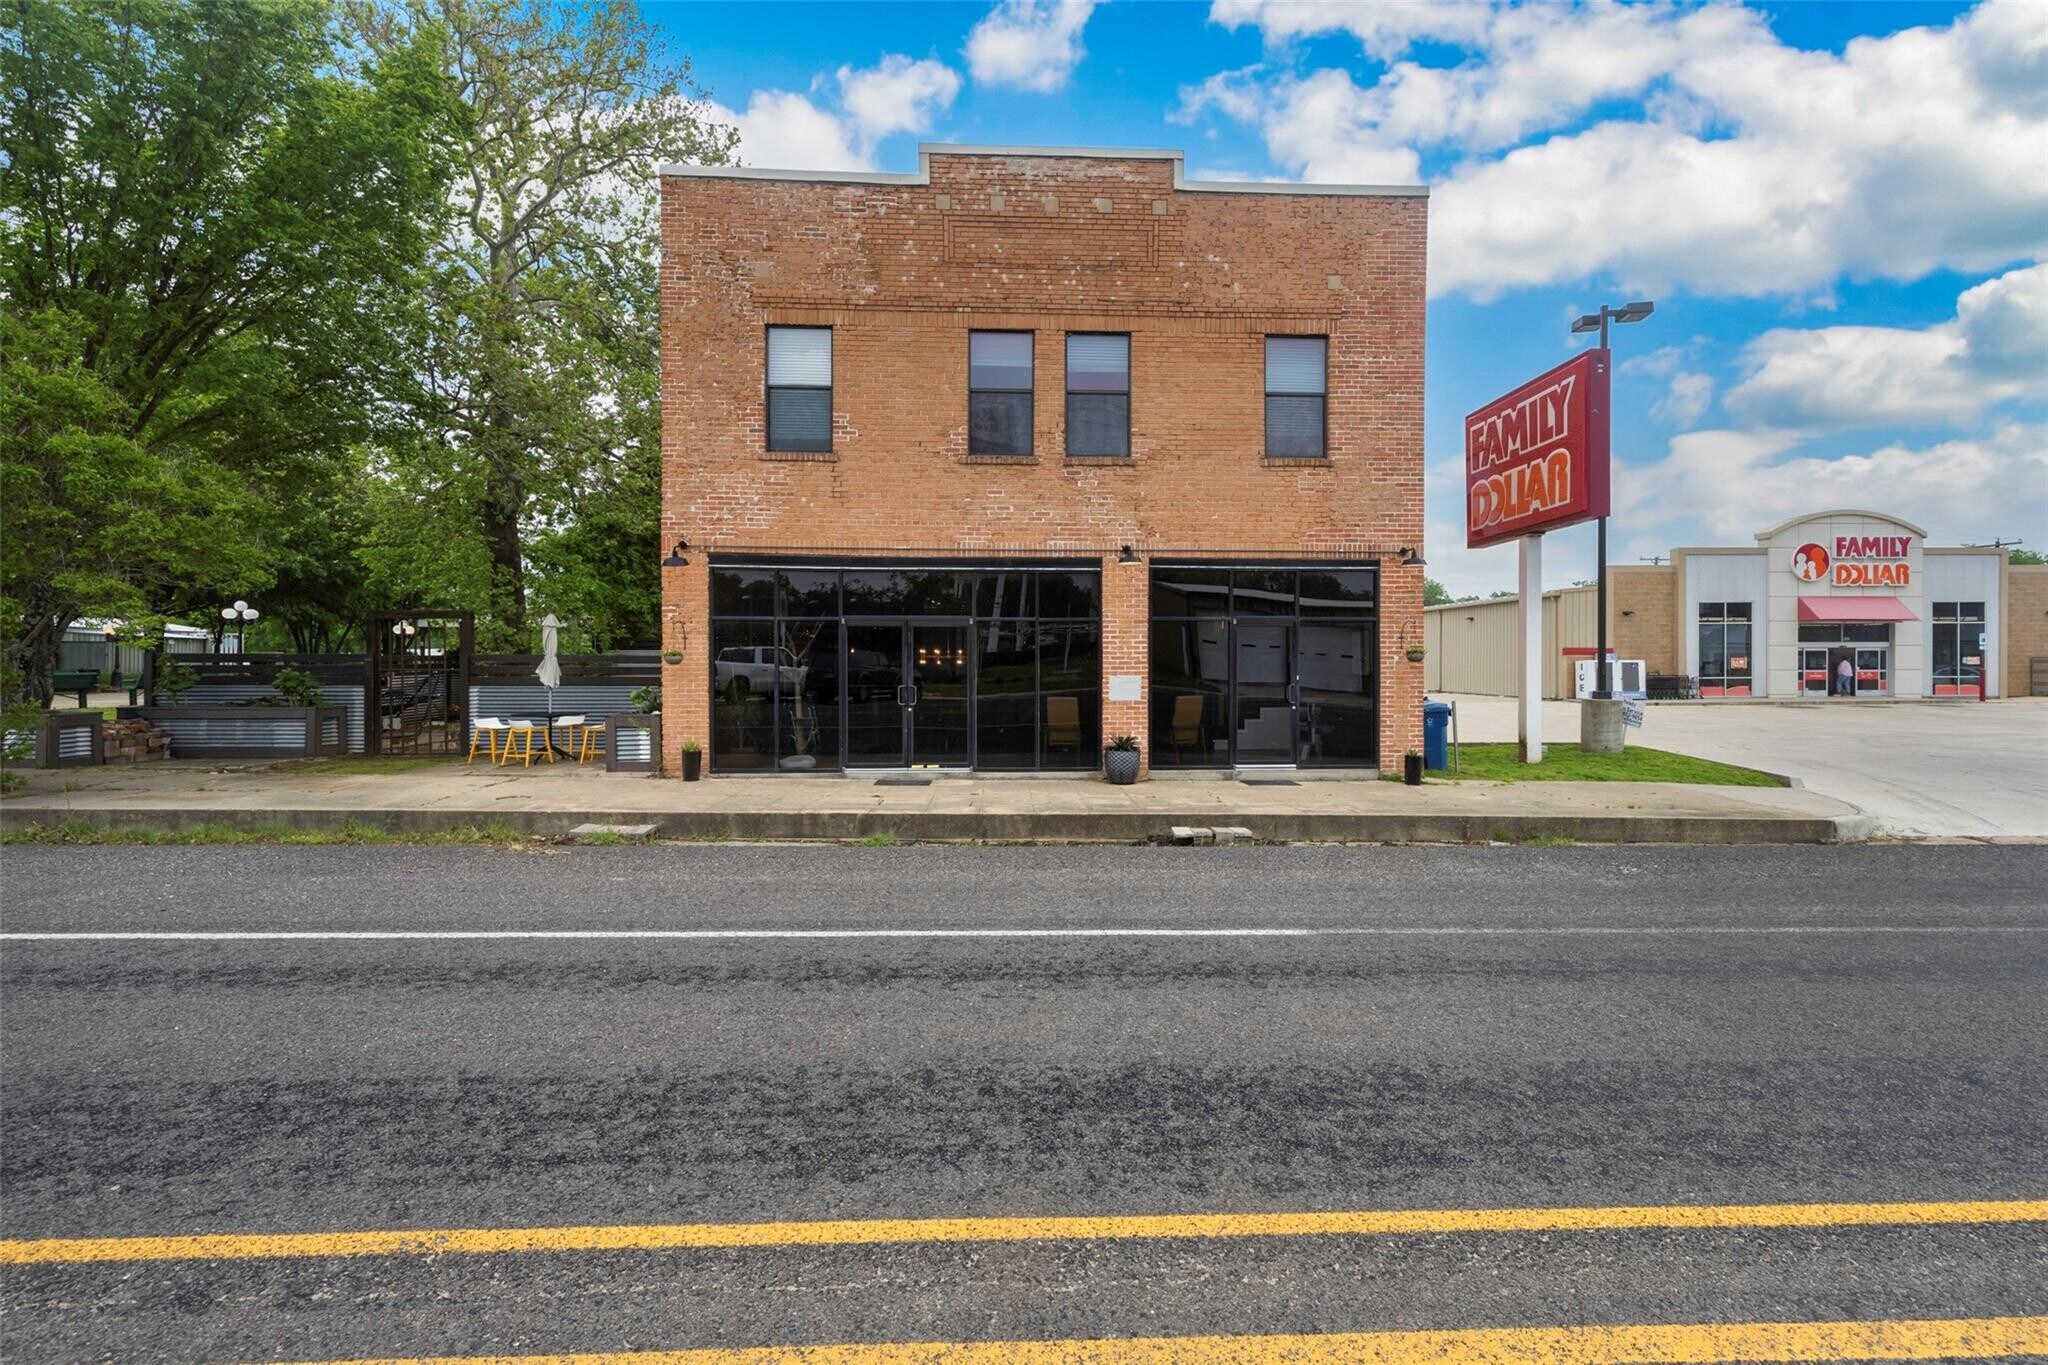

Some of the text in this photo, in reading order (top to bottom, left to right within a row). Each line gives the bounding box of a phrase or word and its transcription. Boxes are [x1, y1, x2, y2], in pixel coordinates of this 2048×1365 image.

[1470, 375, 1576, 474] FAMILY
[1471, 448, 1571, 531] DOLLAR
[1835, 536, 1912, 558] FAMILY
[1835, 563, 1910, 586] DOLLAR
